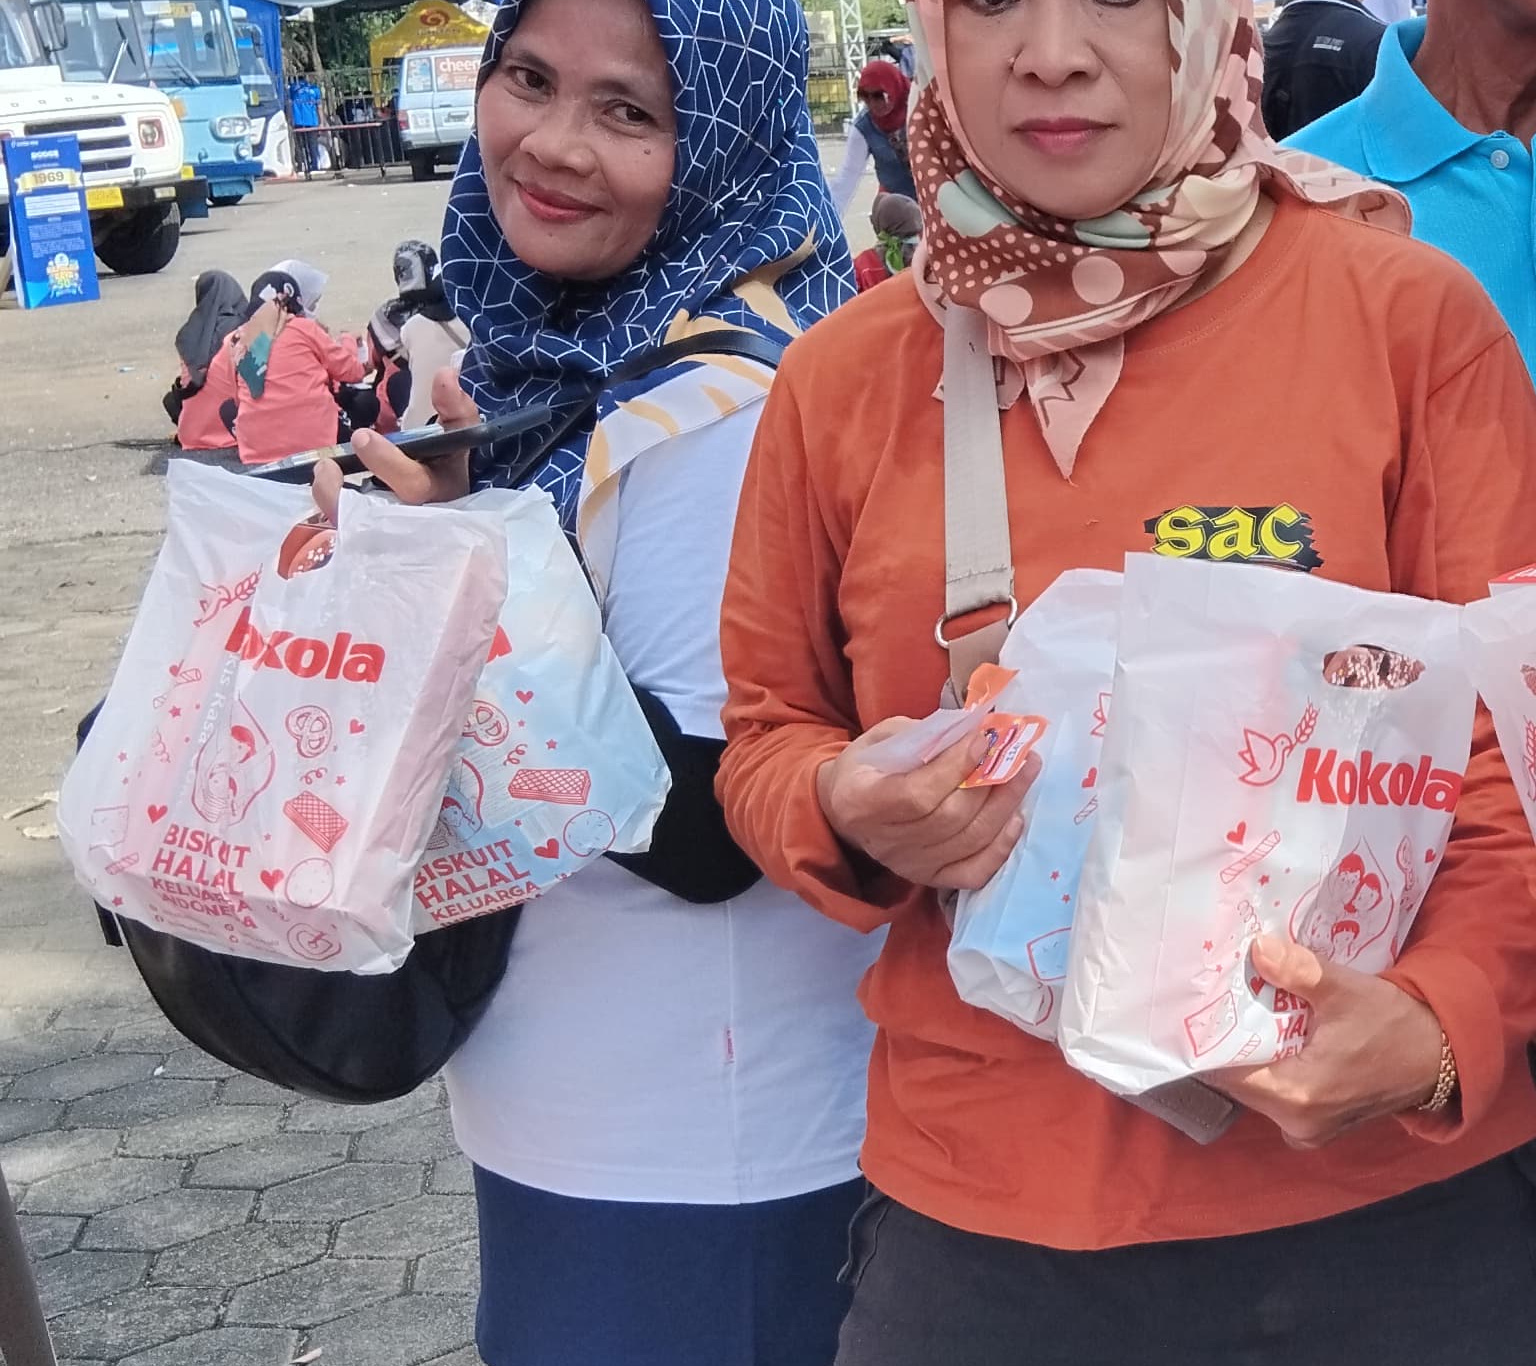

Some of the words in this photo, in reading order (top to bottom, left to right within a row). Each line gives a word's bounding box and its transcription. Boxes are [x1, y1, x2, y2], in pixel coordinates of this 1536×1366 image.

[32, 171, 64, 184] 1969
[1152, 502, 1304, 560] sac
[1296, 747, 1465, 813] Kokola
[414, 838, 514, 889] BISKUIT
[416, 861, 531, 910] HALAL
[430, 880, 541, 922] KELUARGA
